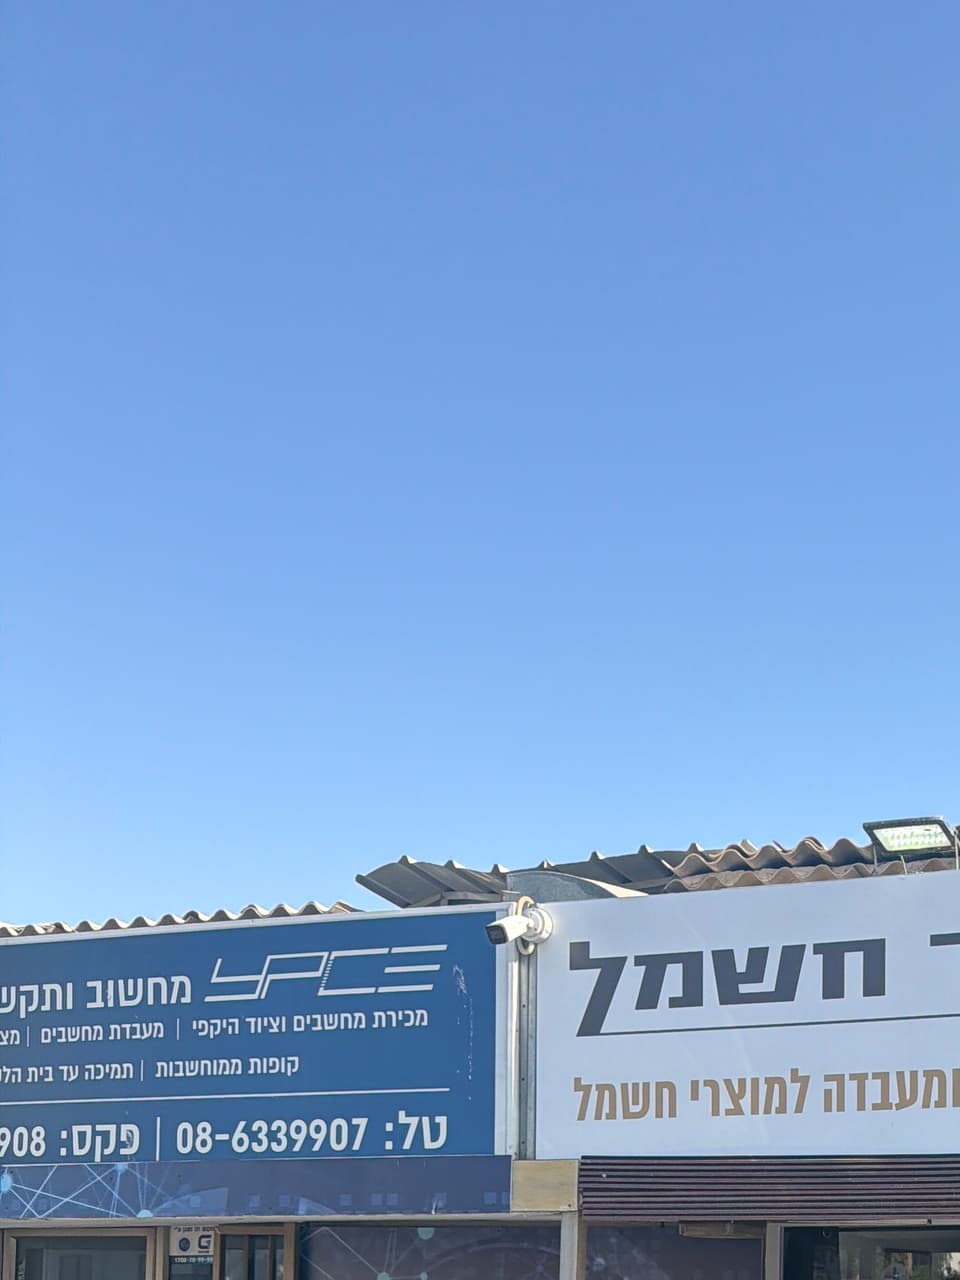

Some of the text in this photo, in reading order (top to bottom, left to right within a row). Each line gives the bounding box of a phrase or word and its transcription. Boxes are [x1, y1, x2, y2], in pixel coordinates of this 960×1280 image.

[86, 974, 192, 1009] מחשוב
[569, 938, 887, 1037] חשמל
[108, 1022, 164, 1040] מעבדת
[192, 1017, 240, 1039] היקפי
[245, 1014, 287, 1034] וציוד
[293, 1012, 367, 1033] מחשבים
[371, 1009, 429, 1028] מכירת
[41, 1025, 104, 1044] מחשבים
[0, 1056, 300, 1084] קופות ממוחשבות תמיכה עד בית הל
[573, 1077, 677, 1122] חשמל
[690, 1067, 811, 1116] למוצרי
[59, 1123, 141, 1162] פקס:
[176, 1117, 369, 1154] 08-6339907
[384, 1110, 448, 1151] טל:
